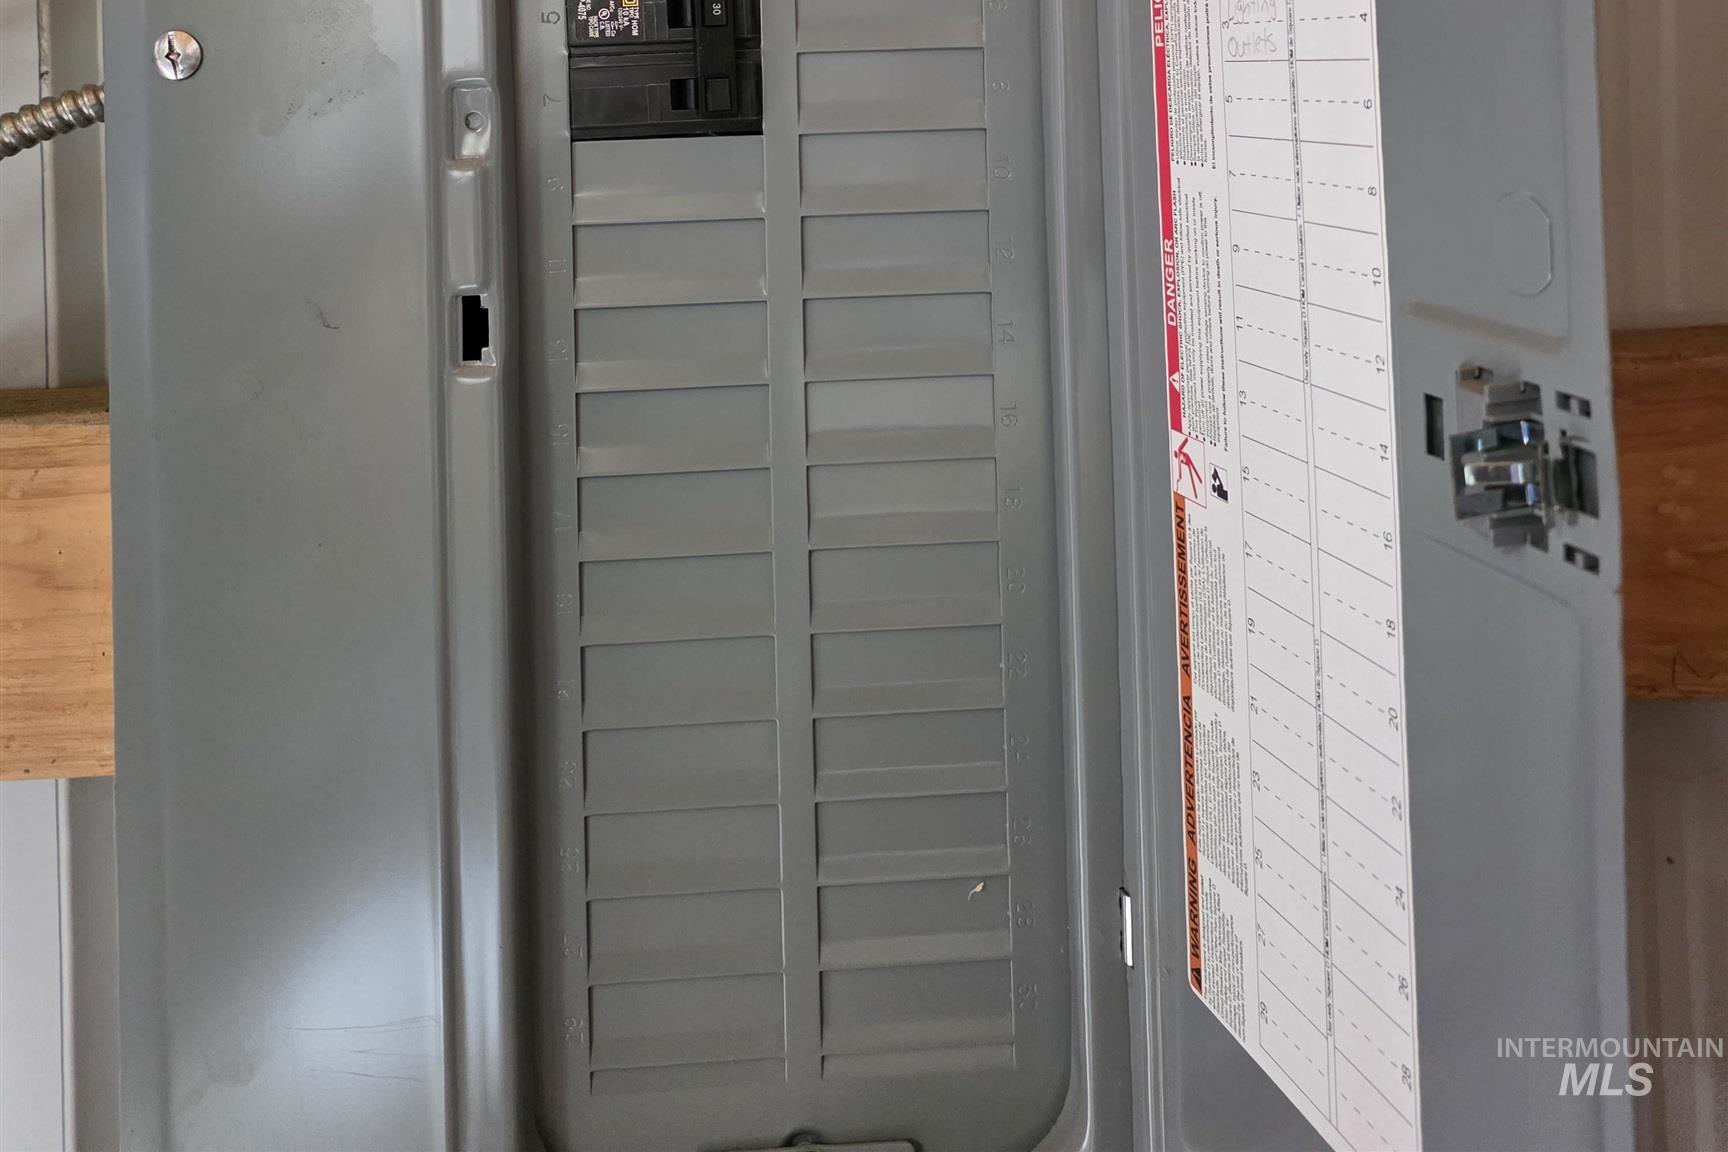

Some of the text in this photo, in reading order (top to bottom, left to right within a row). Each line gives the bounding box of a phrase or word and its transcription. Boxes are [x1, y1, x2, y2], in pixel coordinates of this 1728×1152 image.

[541, 10, 561, 26] 5
[713, 2, 721, 17] 30
[1360, 12, 1368, 23] 4
[624, 17, 629, 26] kA
[1222, 21, 1229, 29] 3
[1228, 28, 1277, 57] Outlets
[543, 93, 563, 107] 7
[1226, 95, 1233, 104] 5
[1363, 98, 1373, 110] 6
[1229, 169, 1237, 178] 7
[1367, 185, 1377, 197] 8
[1233, 244, 1240, 253] 9
[1164, 238, 1177, 326] DANGER
[1371, 267, 1382, 287] 10
[1236, 315, 1243, 331] 11
[1375, 354, 1385, 375] 12
[1239, 389, 1247, 408] 13
[1380, 443, 1389, 463] 14
[1241, 465, 1250, 483] 15
[1245, 540, 1253, 559] 17
[1383, 530, 1393, 551] 16
[1175, 501, 1189, 677] AVERTISSEMENT
[1247, 617, 1256, 635] 19
[1386, 619, 1396, 639] 18
[1250, 695, 1258, 715] 21
[1388, 706, 1399, 732] 20
[1183, 694, 1196, 845] ADVERTENCIA
[1253, 770, 1261, 792] 23
[1391, 795, 1402, 822] 22
[1255, 846, 1263, 870] 25
[1188, 855, 1199, 959] WARNING
[1395, 885, 1406, 912] 24
[1257, 923, 1266, 948] 27
[1398, 974, 1409, 1001] 26
[1261, 1000, 1269, 1025] 29
[1401, 1062, 1412, 1091] 28
